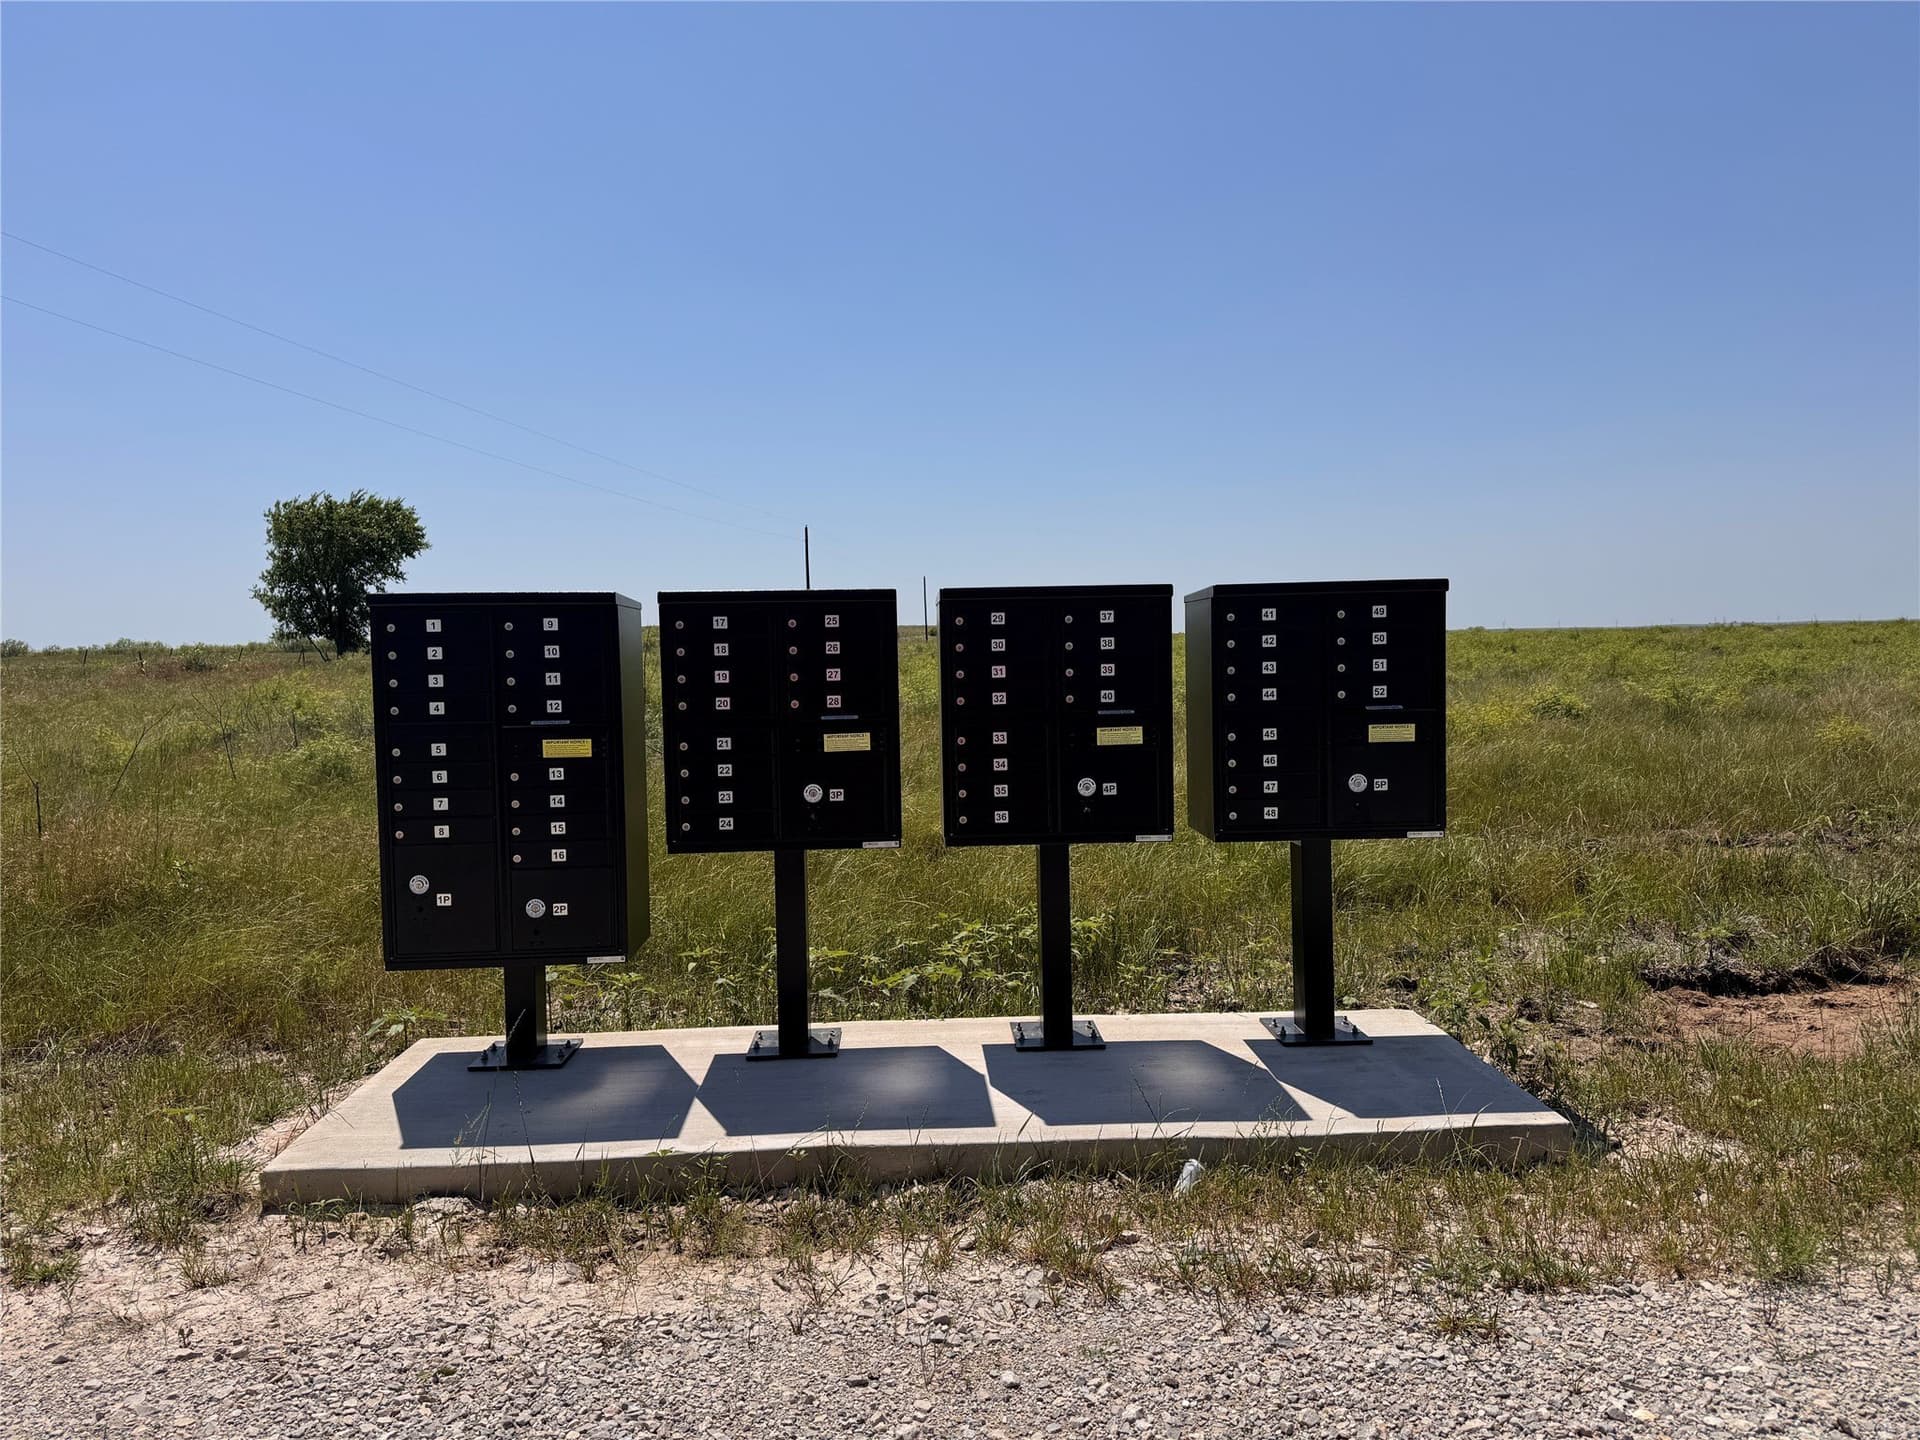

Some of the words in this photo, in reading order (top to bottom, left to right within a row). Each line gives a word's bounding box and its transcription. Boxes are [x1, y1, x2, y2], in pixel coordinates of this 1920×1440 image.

[1263, 610, 1274, 619] 41
[1374, 607, 1385, 616] 49
[826, 616, 838, 626] 25
[992, 614, 1004, 623] 29
[1101, 612, 1113, 621] 37
[430, 621, 436, 630] 1
[547, 620, 554, 629] 9
[714, 618, 726, 627] 17
[1263, 636, 1275, 646] 42
[1374, 634, 1385, 643] 50
[827, 643, 839, 653] 26
[993, 640, 1004, 650] 30
[1102, 639, 1113, 648] 38
[431, 648, 438, 658] 2
[546, 647, 558, 657] 10
[715, 645, 727, 655] 18
[1102, 665, 1113, 674] 39
[1263, 663, 1275, 672] 43
[1374, 660, 1385, 670] 51
[716, 672, 728, 681] 19
[827, 670, 839, 679] 27
[993, 667, 1003, 677] 31
[432, 676, 439, 686] 3
[547, 674, 558, 684] 11
[1102, 692, 1113, 701] 40
[1264, 690, 1275, 698] 44
[1374, 687, 1385, 697] 52
[828, 697, 840, 706] 28
[993, 694, 1005, 703] 32
[548, 702, 561, 711] 12
[717, 699, 729, 708] 20
[433, 704, 440, 713] 4
[994, 733, 1006, 743] 33
[1264, 729, 1276, 738] 45
[718, 739, 729, 748] 21
[435, 745, 442, 754] 5
[995, 760, 1006, 769] 34
[1264, 756, 1276, 765] 46
[551, 769, 563, 779] 13
[719, 766, 731, 775] 22
[436, 772, 443, 782] 6
[1104, 784, 1116, 793] 4P
[1265, 782, 1276, 791] 47
[1375, 780, 1387, 789] 5P
[831, 790, 843, 800] 3P
[995, 786, 1007, 796] 35
[551, 796, 563, 806] 14
[720, 792, 731, 802] 23
[437, 799, 444, 808] 7
[996, 812, 1007, 822] 36
[1265, 808, 1277, 818] 48
[552, 823, 564, 833] 15
[720, 819, 732, 828] 24
[438, 827, 445, 836] 8
[553, 851, 565, 860] 16
[438, 895, 450, 904] 1P
[554, 905, 567, 914] 2P
